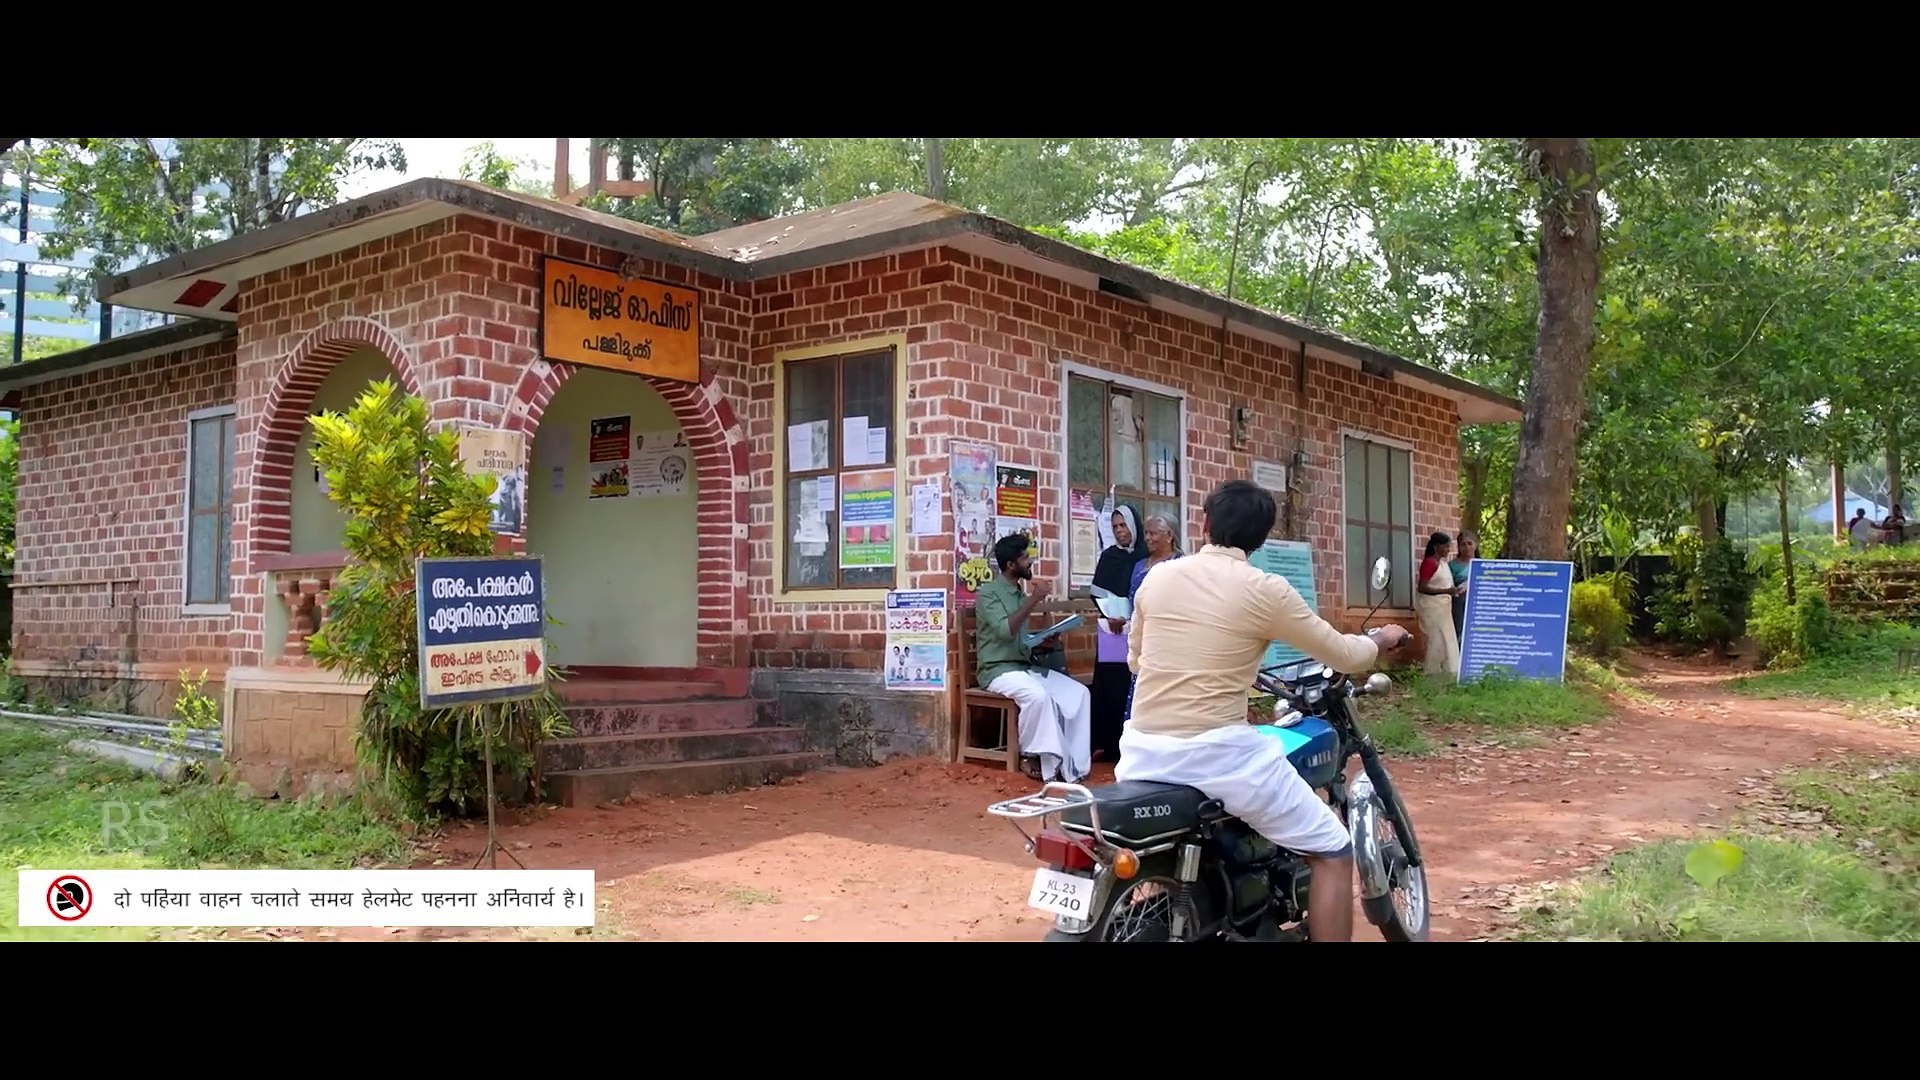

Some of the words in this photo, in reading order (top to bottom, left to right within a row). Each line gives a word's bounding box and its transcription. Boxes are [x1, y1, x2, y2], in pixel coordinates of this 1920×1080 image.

[553, 275, 624, 321] വില്ലേജ്
[627, 292, 693, 332] ഓഫീസ്
[432, 571, 534, 599] അപേക്ഷകൾ
[430, 651, 483, 669] അപേക്ഷ
[441, 670, 484, 687] ഇവിടെ
[1133, 806, 1152, 819] RX
[1153, 804, 1172, 817] 100
[1038, 890, 1081, 911] 7740
